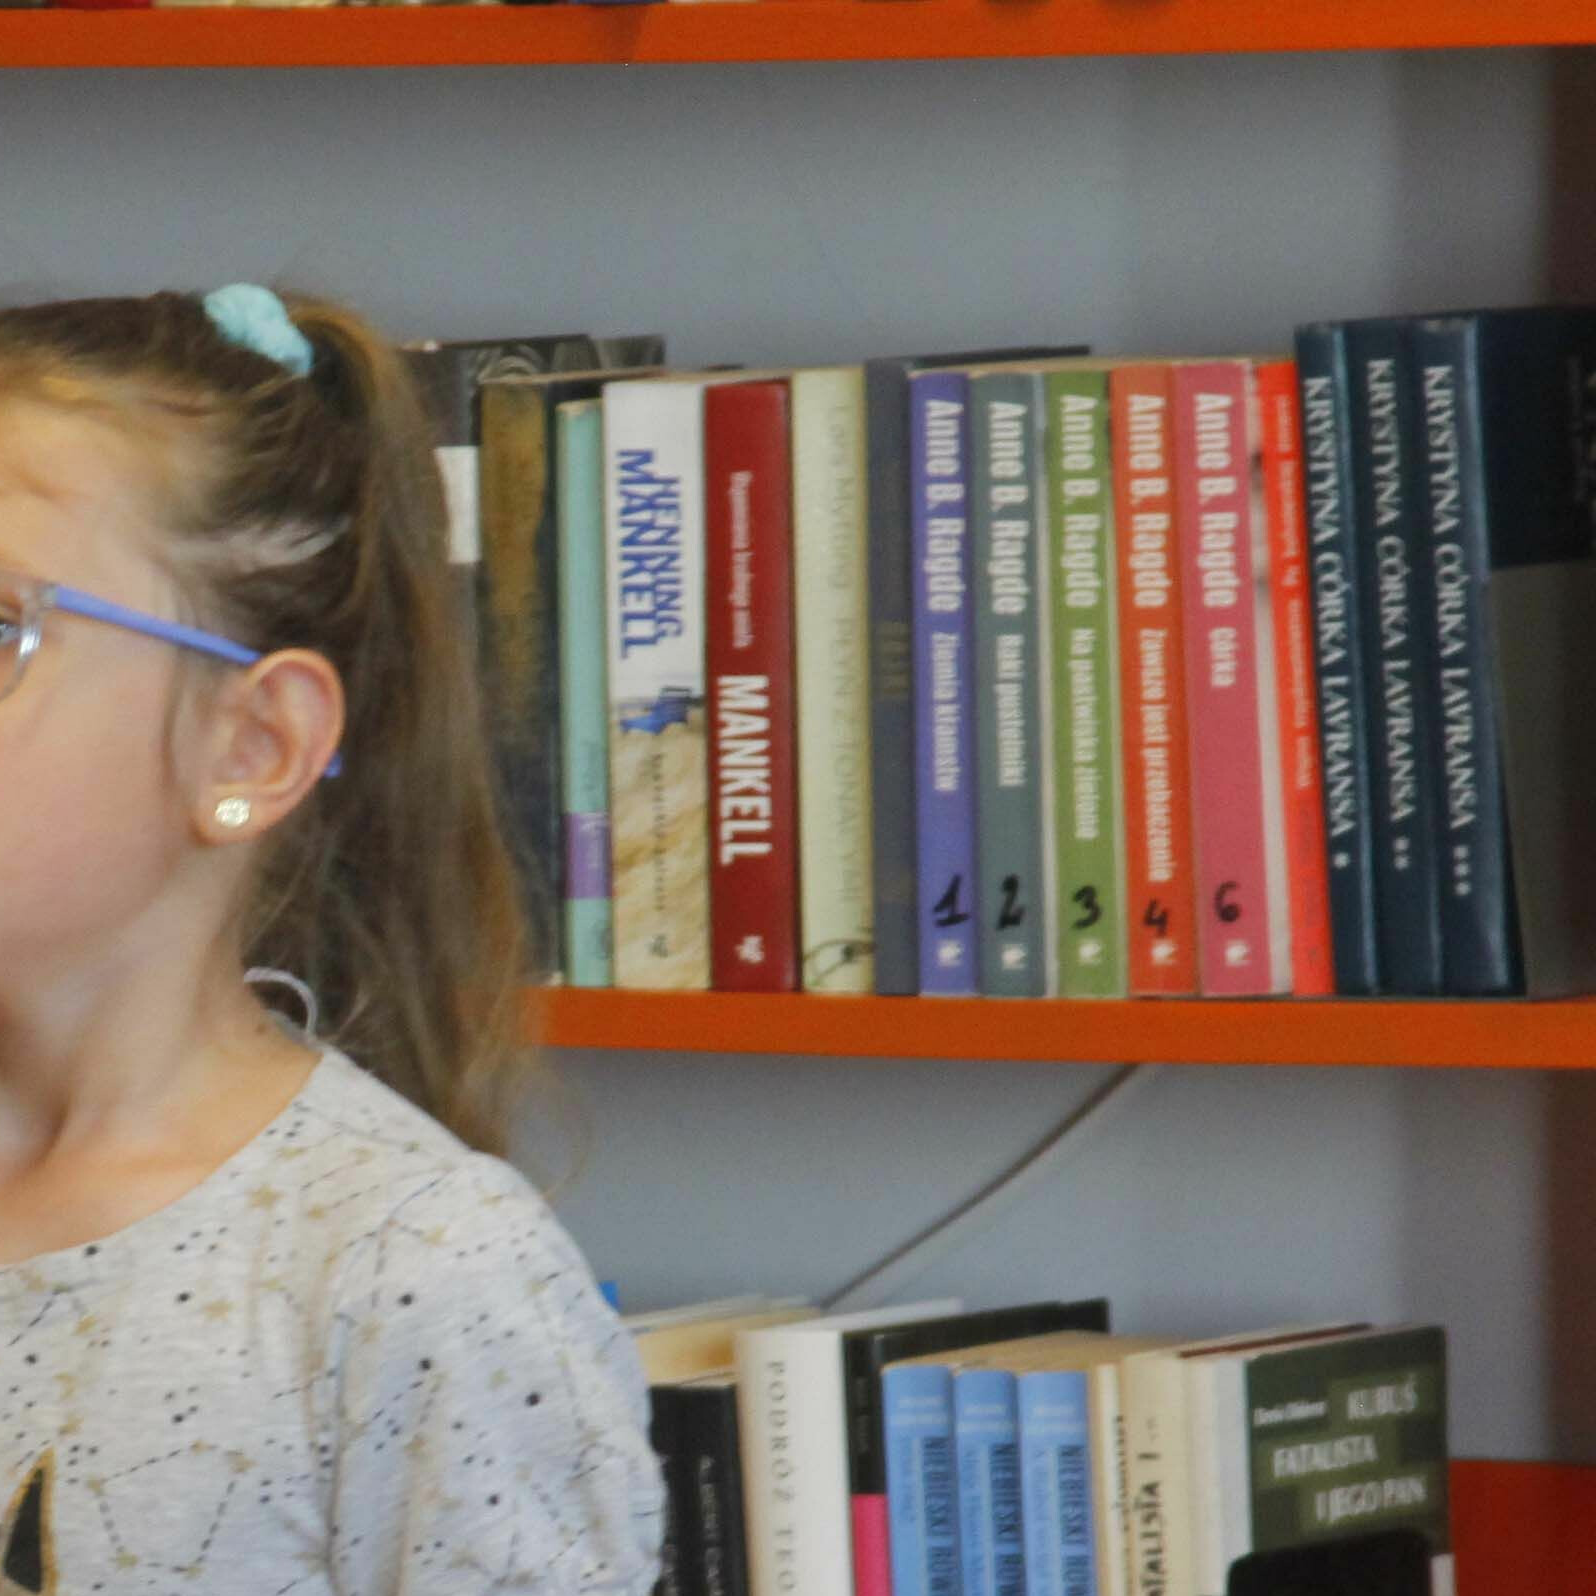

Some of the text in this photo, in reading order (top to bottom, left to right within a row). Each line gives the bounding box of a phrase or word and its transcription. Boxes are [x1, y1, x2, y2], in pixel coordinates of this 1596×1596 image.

[617, 448, 657, 660] MANKELL
[650, 472, 684, 640] HENNING
[921, 399, 965, 791] Anne B. Ragde Ziemia kłamstw
[984, 401, 1029, 788] Anne B. Ragde Raki pustelniki
[1058, 394, 1102, 841] Anne B. Ragde Na pastwiska zielone
[1191, 391, 1241, 689] Anne B. Ragde Córka
[1303, 376, 1356, 838] KRYSTYNA CÓRKA LAVRANSA
[1366, 358, 1417, 824] KRYSTYNA CÓRKA LAVRANSA
[1421, 363, 1478, 831] KRYSTYNA CÓRKA LAVRANSA
[1125, 393, 1177, 884] Anne B. Ragde Zawsze jest przebaczenie
[715, 674, 769, 867] MANKELL
[931, 872, 973, 928] 1
[996, 872, 1026, 931] 2
[1071, 883, 1103, 931] 3
[1141, 897, 1173, 938] 4
[1213, 880, 1243, 925] 6
[763, 1360, 799, 1595] PODRÓŻ TEO
[921, 1436, 956, 1540] NIEBIESKI
[990, 1441, 1022, 1549] NIEBIESKI
[1053, 1442, 1089, 1550] NIEBIESKI
[1273, 1434, 1379, 1478] FATALISTA
